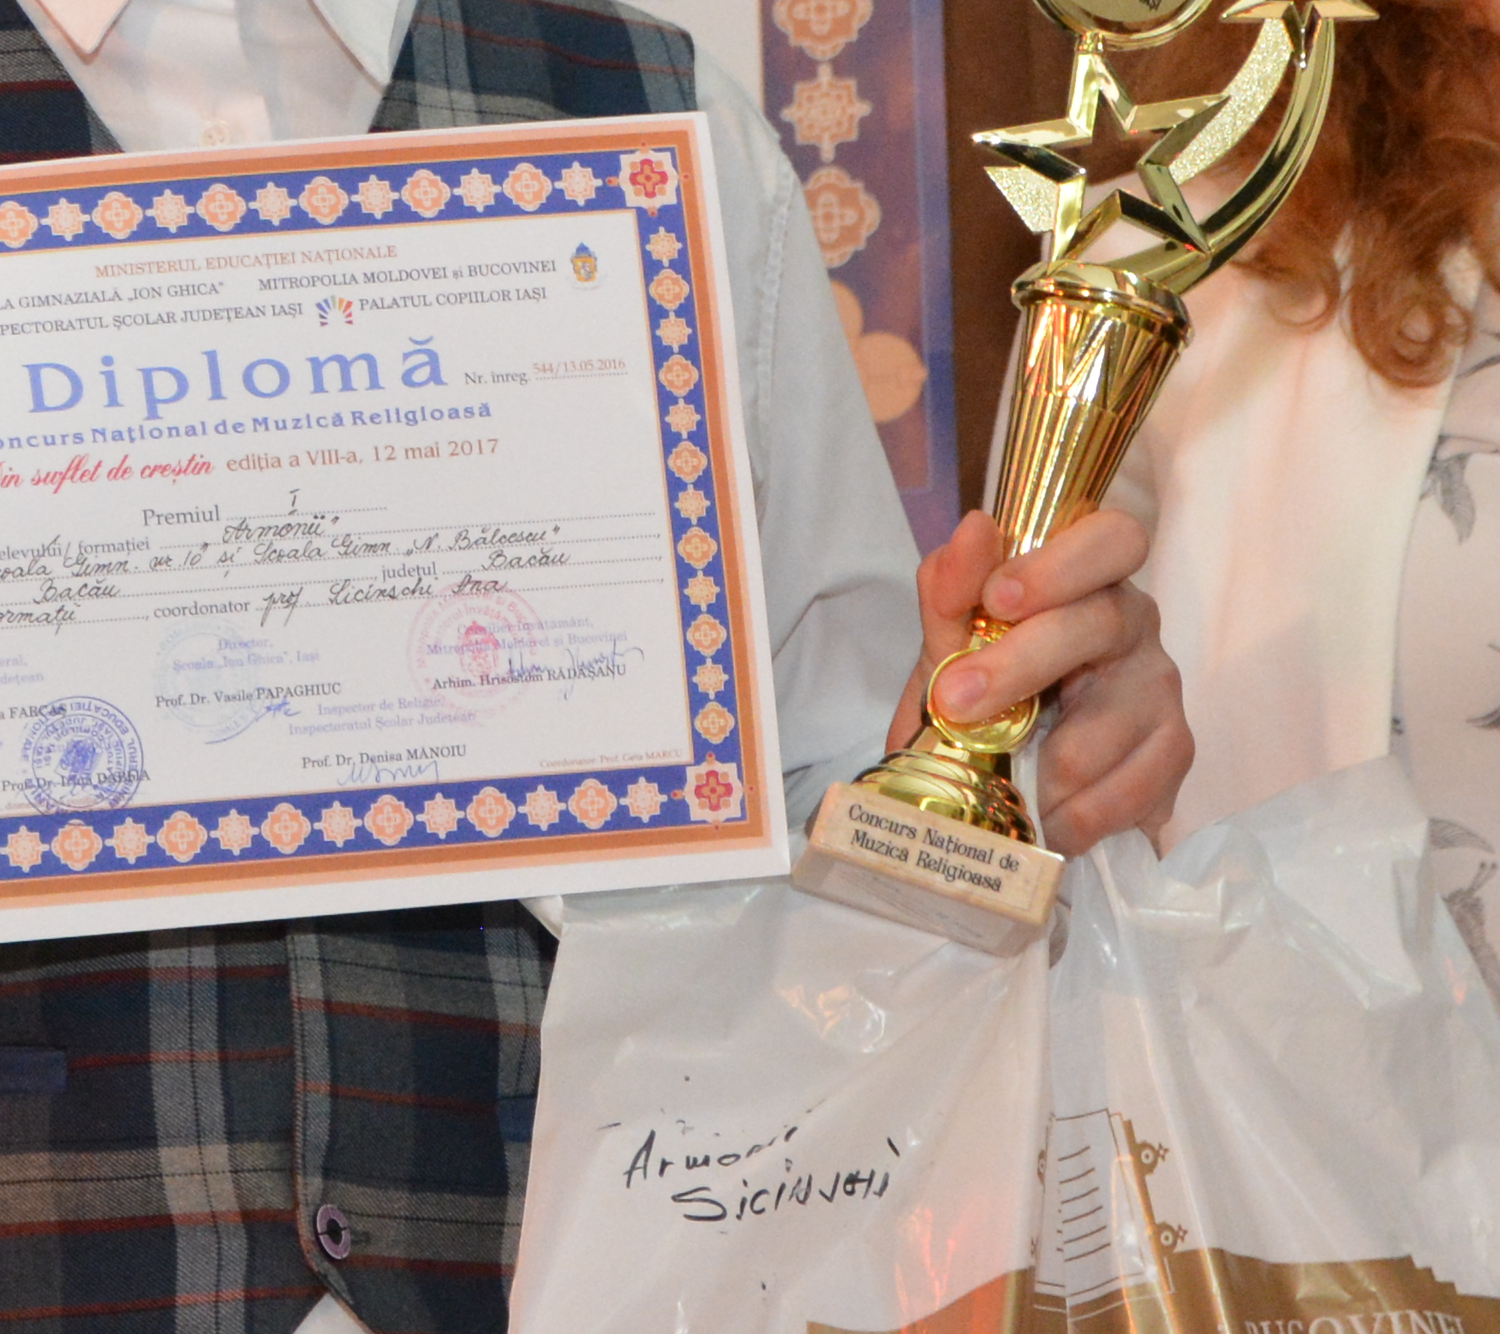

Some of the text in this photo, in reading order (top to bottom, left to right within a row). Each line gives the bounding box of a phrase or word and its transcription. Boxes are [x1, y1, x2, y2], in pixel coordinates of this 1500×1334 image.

[94, 257, 201, 279] MINISTERUL
[257, 272, 359, 292] MITROPOLIA
[362, 266, 449, 285] MOLDOVEI
[467, 259, 558, 279] BUCOVINEI
[358, 294, 433, 313] PALATUL
[435, 288, 513, 307] COPIILOR
[20, 335, 449, 421] Diplomă
[463, 371, 487, 386] Nr.
[213, 418, 247, 436] de
[251, 403, 346, 434] Muzică
[350, 401, 493, 428] Religioasă
[29, 454, 101, 495] suflet
[105, 455, 135, 482] de
[287, 454, 302, 468] a
[305, 447, 364, 467] VIII-a,
[371, 443, 398, 462] 12
[403, 441, 442, 461] mai
[447, 437, 500, 457] 2017
[141, 503, 222, 527] Premiul
[153, 599, 251, 619] coordonator
[154, 681, 343, 709] Prof. Dr. Vasile PAPAGHIUC
[431, 676, 478, 691] Arhim.
[317, 702, 377, 718] Inspector
[378, 698, 395, 712] de
[288, 717, 373, 738] Inspectoratul
[301, 754, 333, 770] Prof.
[334, 752, 356, 767] Dr.
[358, 749, 403, 766] Denisa
[847, 803, 918, 840] Concurs
[998, 851, 1020, 873] de
